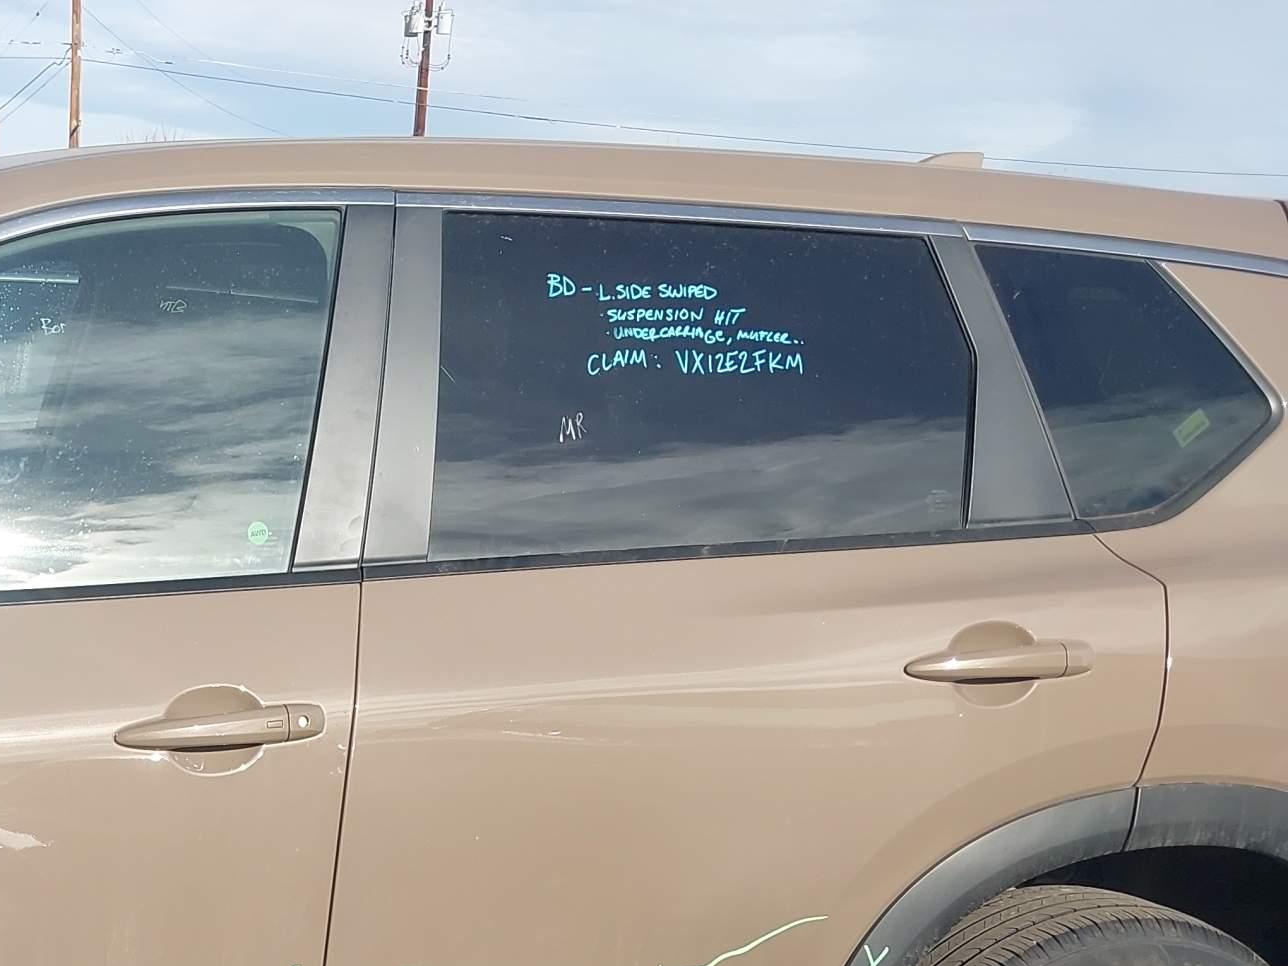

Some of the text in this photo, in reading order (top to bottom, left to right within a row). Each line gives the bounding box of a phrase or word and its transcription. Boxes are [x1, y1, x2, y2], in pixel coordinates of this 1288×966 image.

[546, 273, 576, 298] BD
[657, 283, 718, 300] SWIPED
[606, 307, 747, 326] SUSPENSION HIT
